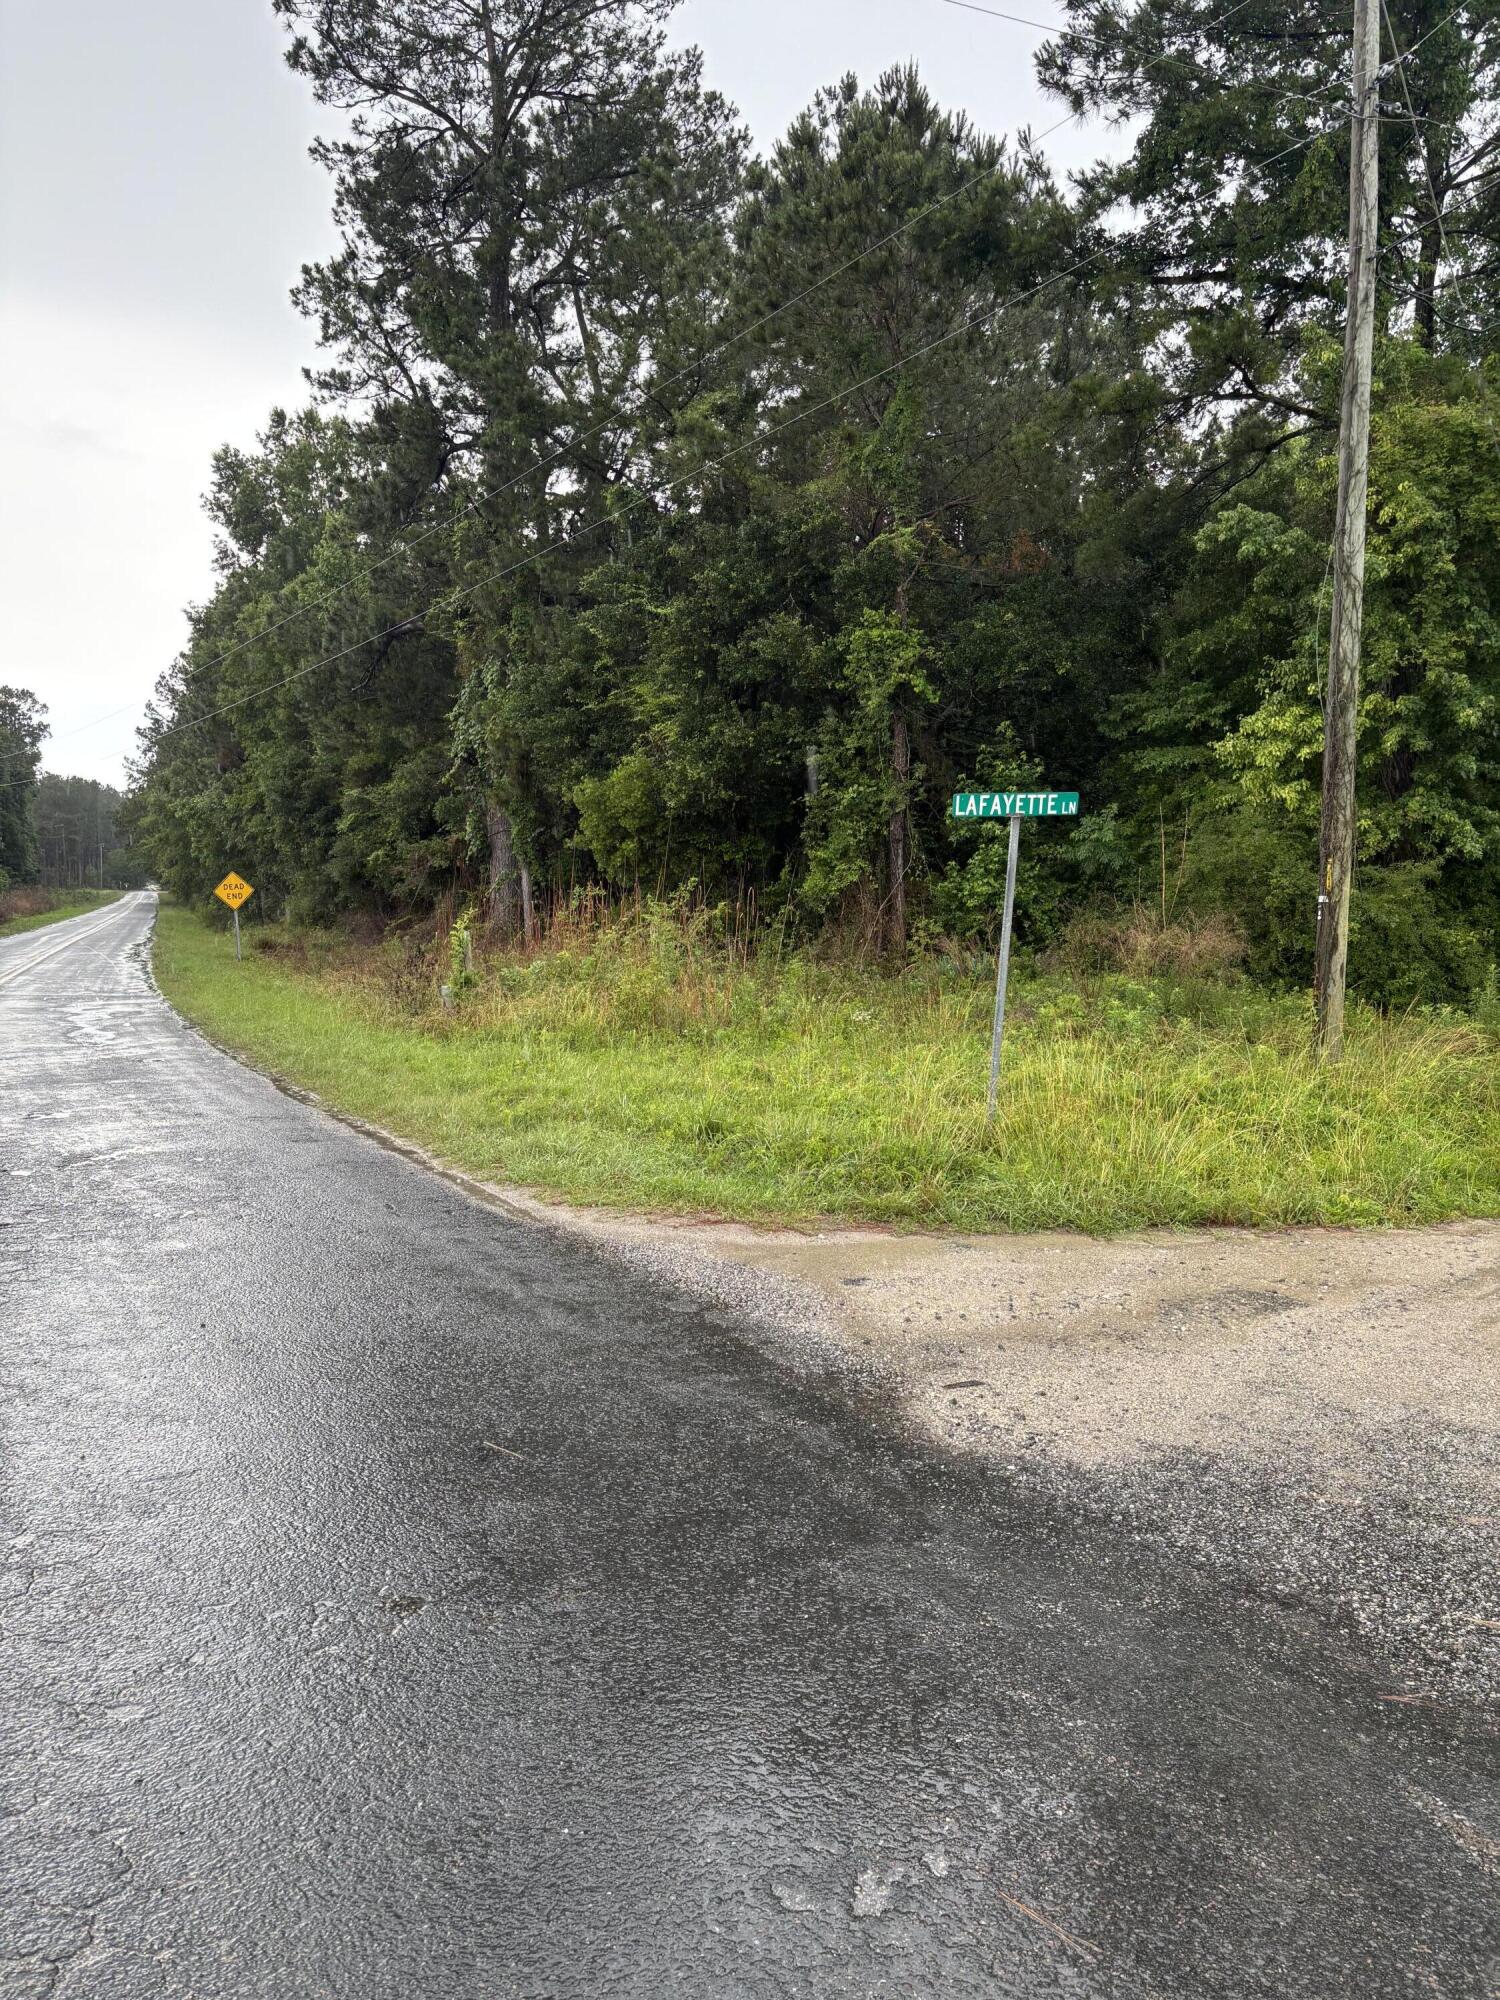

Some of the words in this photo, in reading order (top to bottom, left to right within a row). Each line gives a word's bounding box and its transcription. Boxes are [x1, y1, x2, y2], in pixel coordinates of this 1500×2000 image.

[955, 794, 1058, 816] LAFAYETTE
[1061, 801, 1077, 815] LN
[223, 882, 245, 891] DEAD
[226, 892, 243, 900] END
